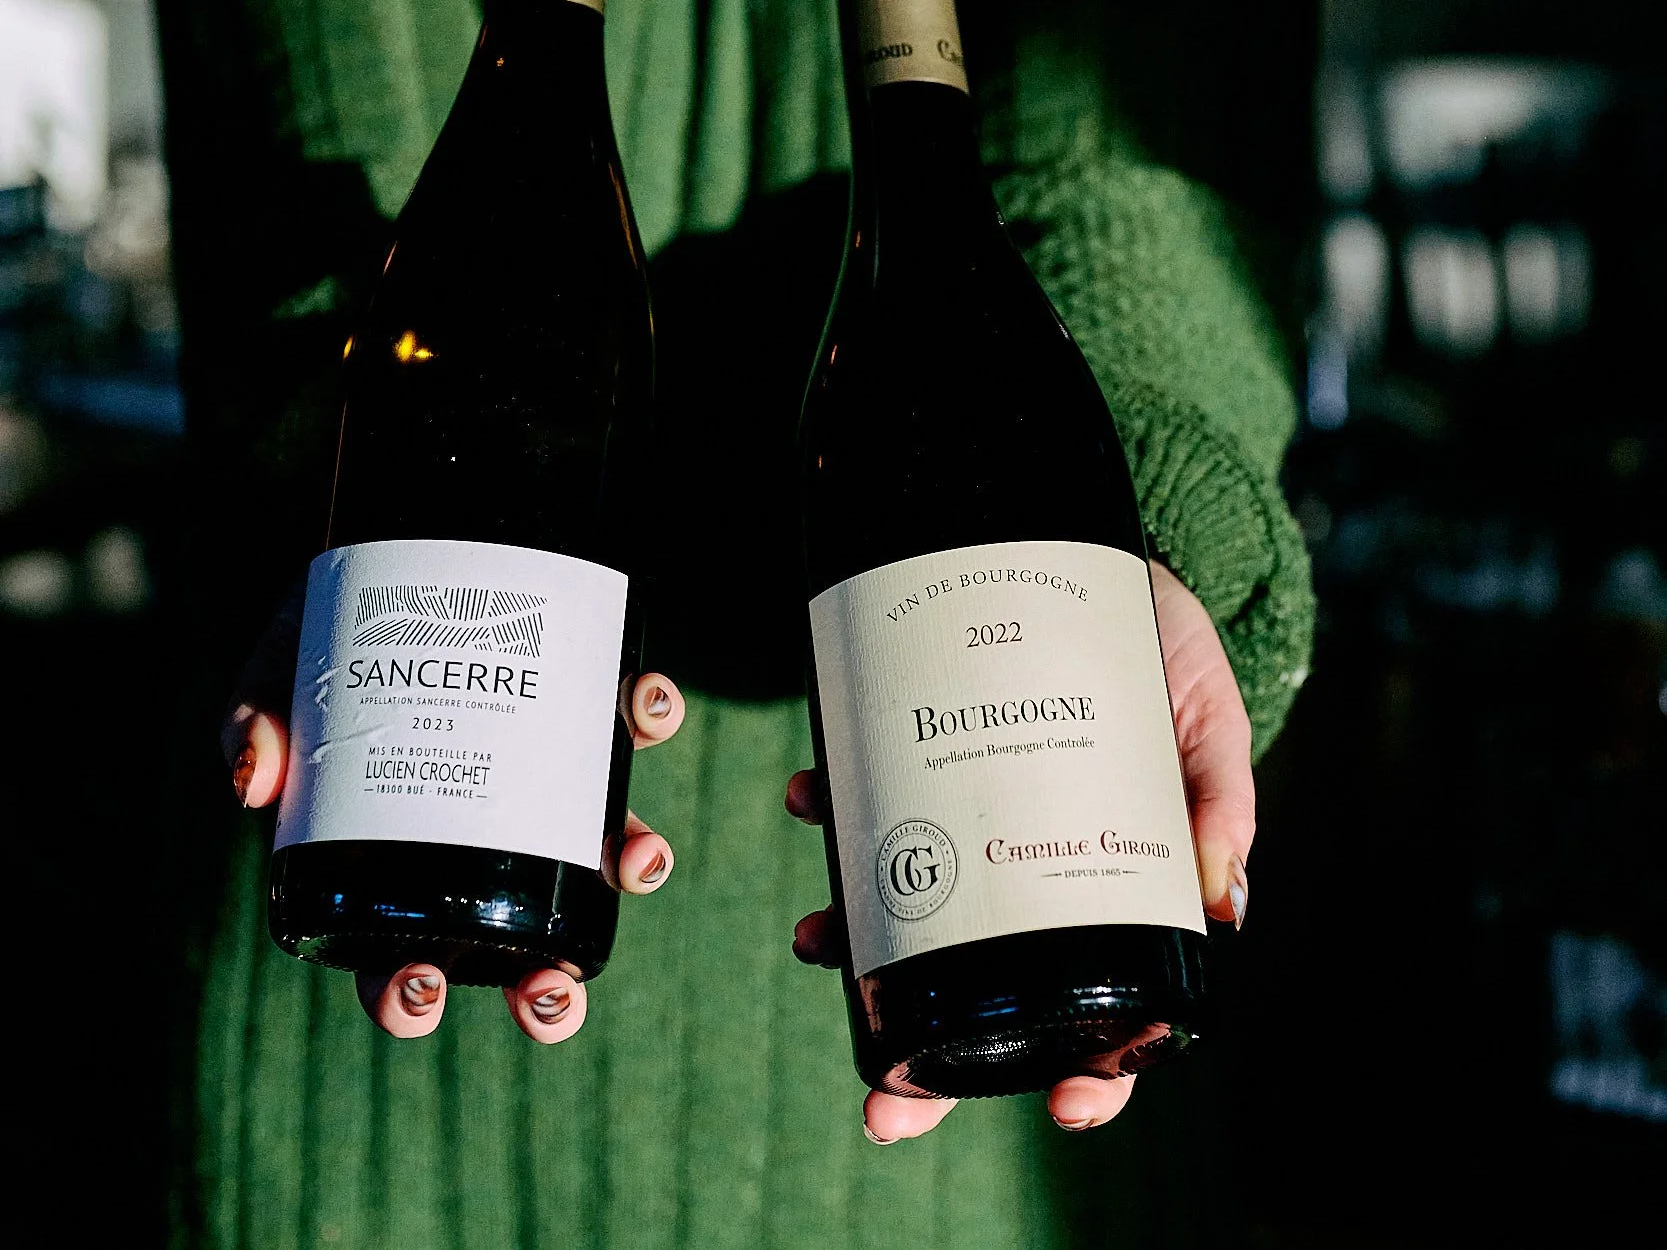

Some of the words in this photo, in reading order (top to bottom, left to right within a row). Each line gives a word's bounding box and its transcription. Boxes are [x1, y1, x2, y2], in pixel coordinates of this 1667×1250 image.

[886, 592, 921, 624] VIN
[924, 578, 953, 601] DE
[958, 568, 1088, 602] BOURGOGNE
[965, 621, 1023, 649] 2022
[346, 658, 539, 699] SANCERRE
[359, 696, 413, 705] APPELLATION
[416, 697, 461, 708] SANCERRE
[465, 700, 516, 714] CONTRÔLÉE
[411, 717, 454, 732] 2023
[911, 696, 1095, 744] BOURGOGNE
[368, 746, 386, 756] MIS
[391, 746, 404, 756] EN
[409, 747, 467, 760] BOUTEILLE
[473, 752, 492, 762] PAR
[924, 747, 984, 770] Appellation
[986, 741, 1045, 757] Bourgogne
[365, 760, 416, 780] LUCIEN
[419, 761, 490, 785] CROCHET
[376, 784, 403, 795] 18300
[407, 784, 424, 795] BUÉ
[437, 786, 473, 799] FRANCE
[985, 839, 1091, 865] CAMILLE
[1099, 830, 1170, 859] GIROUD
[1064, 868, 1098, 879] DEPUIS
[1101, 867, 1121, 878] 1865
